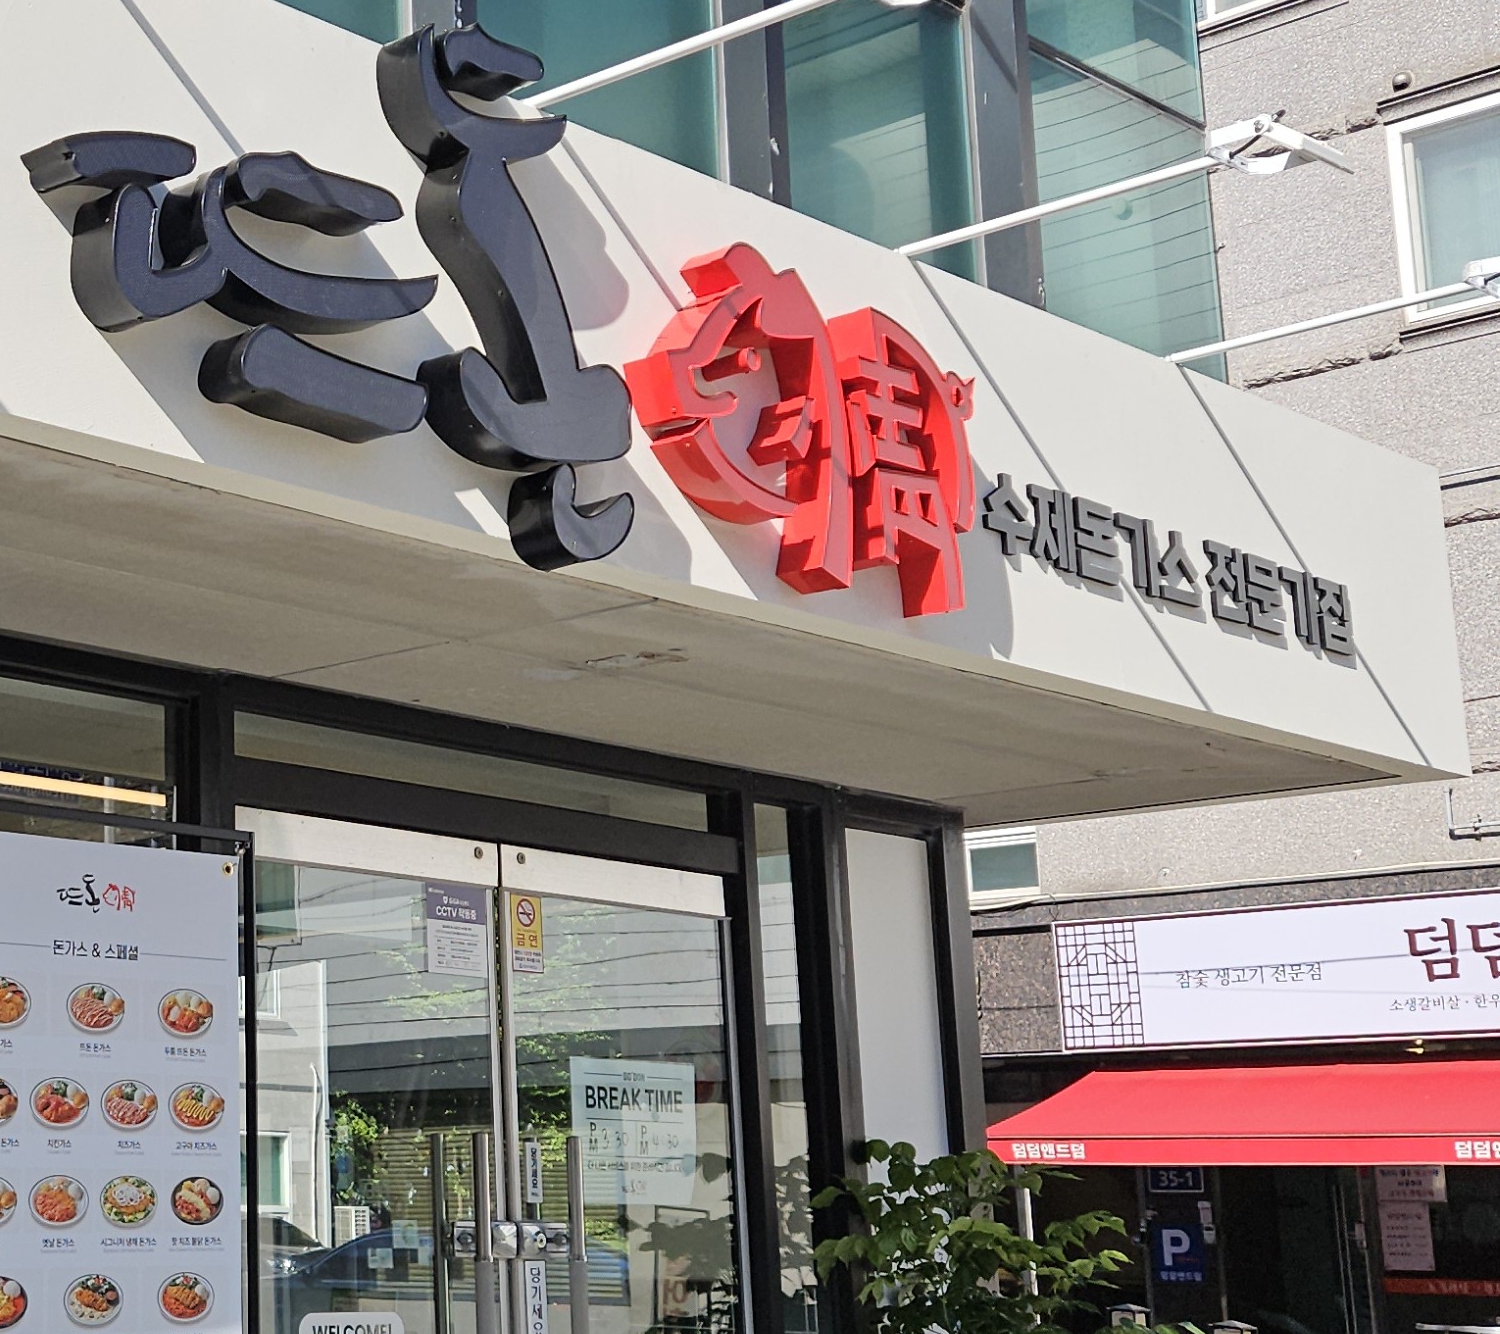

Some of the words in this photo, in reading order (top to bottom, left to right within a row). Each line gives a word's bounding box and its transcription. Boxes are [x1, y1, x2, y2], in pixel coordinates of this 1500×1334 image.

[436, 906, 458, 918] CCTV
[53, 939, 88, 957] 돈가스
[91, 943, 101, 958] &
[104, 944, 139, 961] 스페셜
[1214, 966, 1265, 987] 생고기
[1269, 961, 1322, 983] 전문점
[1389, 995, 1460, 1012] 소생갈비살
[585, 1085, 642, 1110] BREAK
[645, 1089, 683, 1113] TIME
[1011, 1142, 1086, 1160] 덤덤앤드덤
[1159, 1170, 1193, 1187] 35-1
[1161, 1229, 1191, 1266] P
